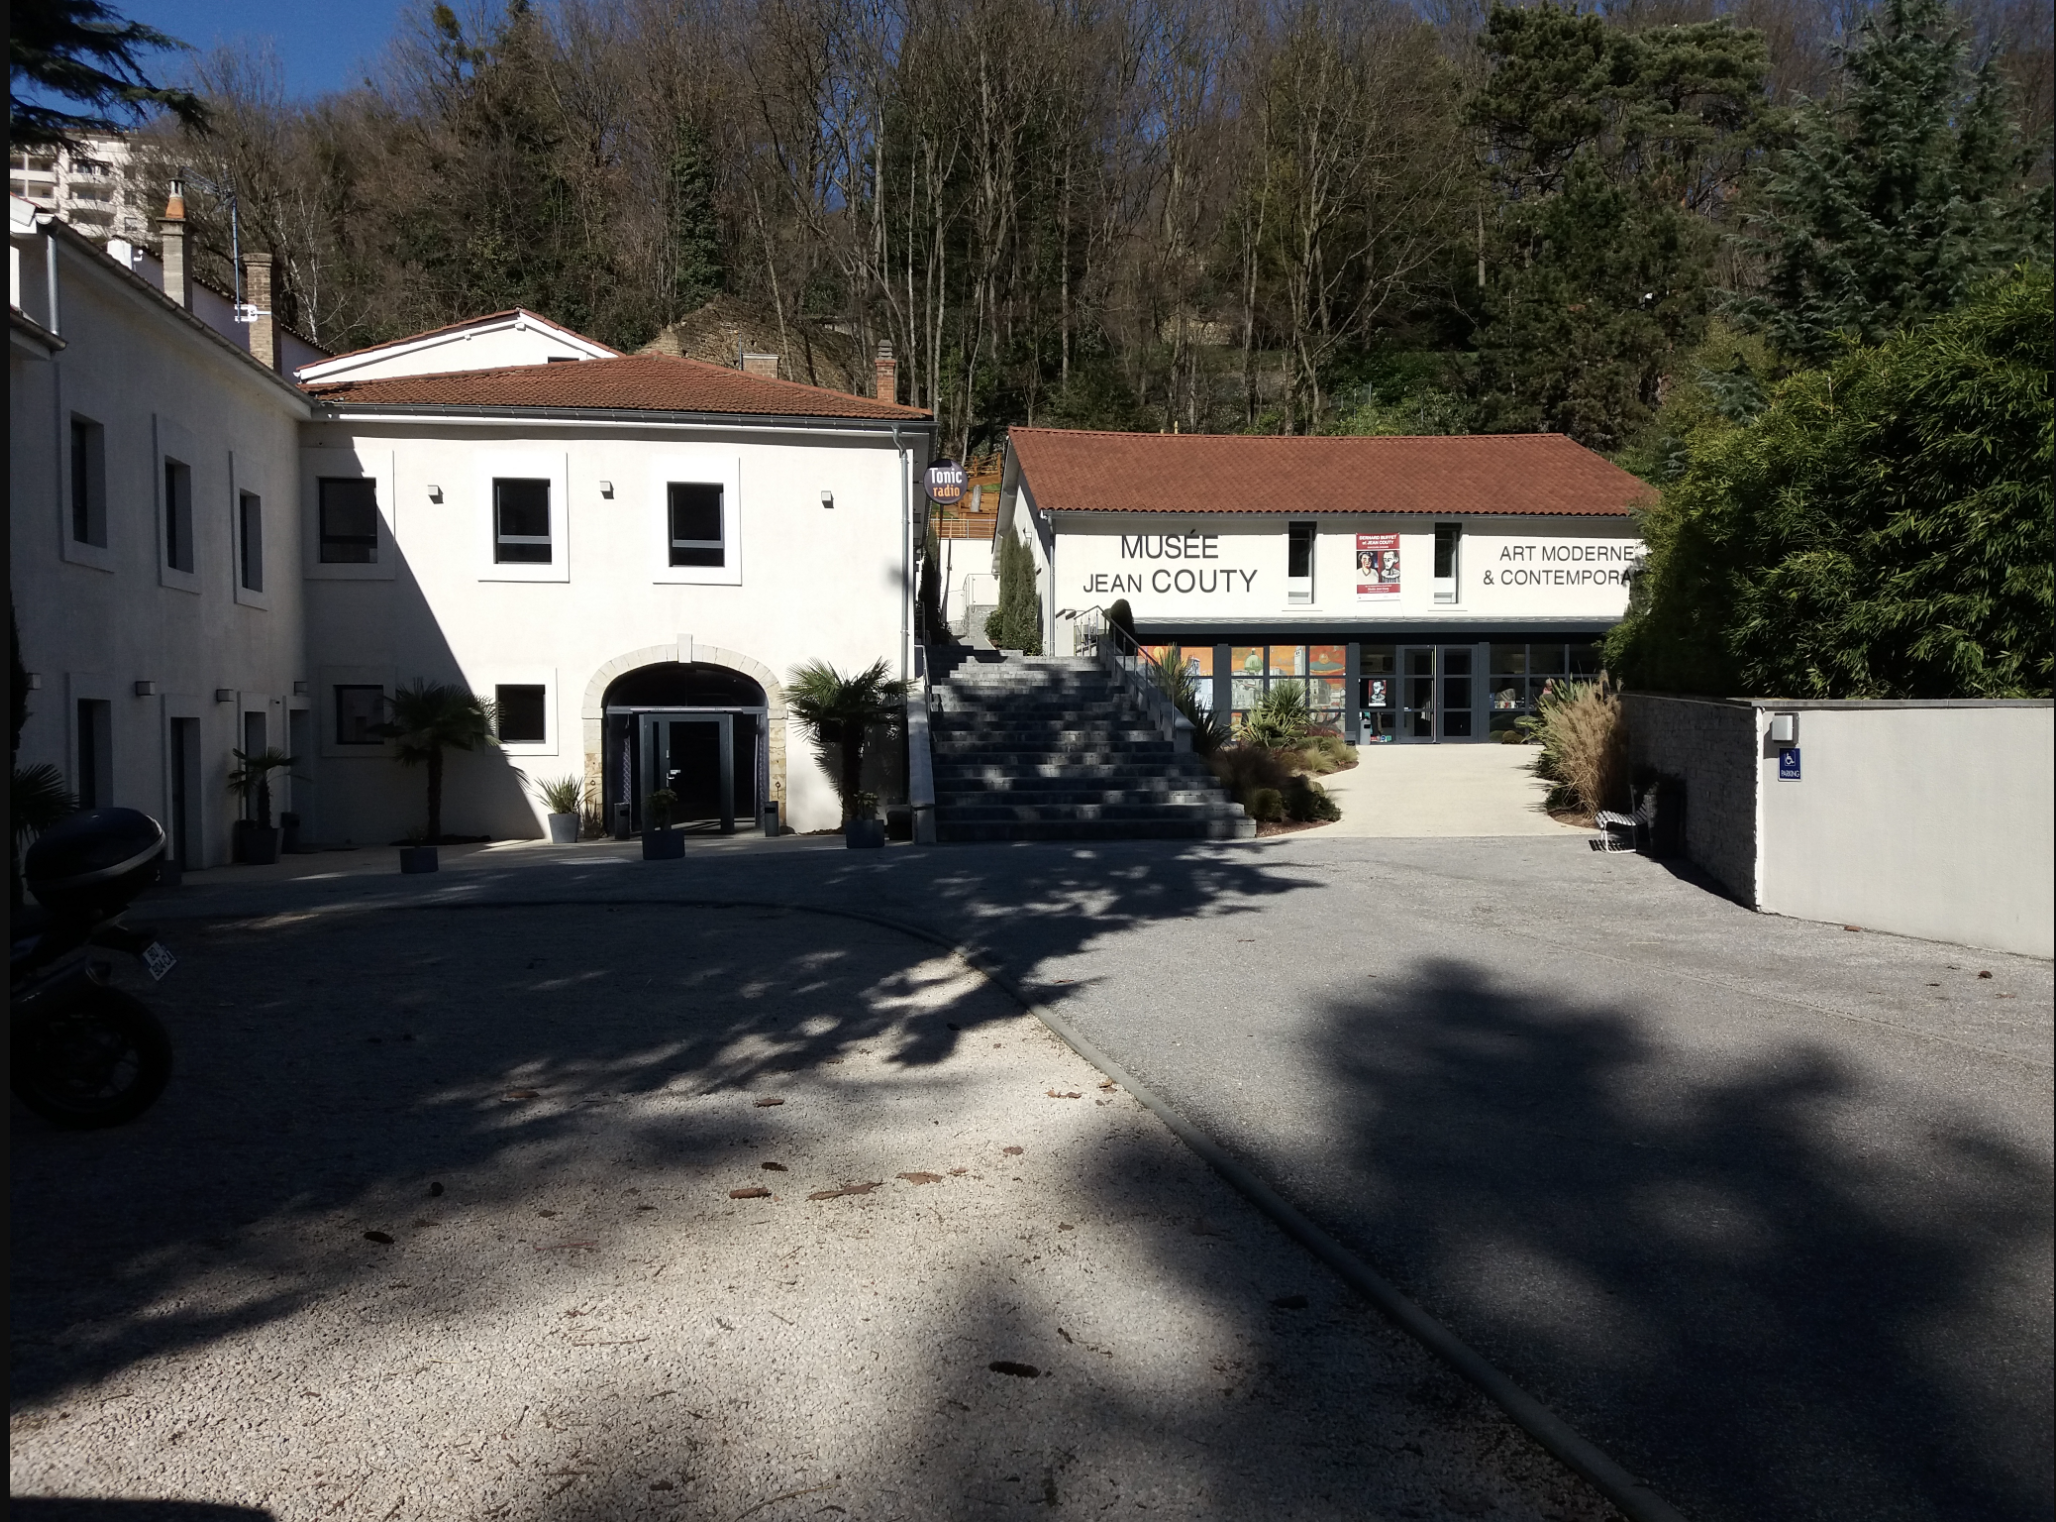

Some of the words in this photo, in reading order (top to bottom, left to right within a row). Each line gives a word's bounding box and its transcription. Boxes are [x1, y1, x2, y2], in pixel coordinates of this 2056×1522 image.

[929, 467, 963, 484] Tonic
[933, 484, 961, 497] radio
[1121, 528, 1219, 559] MUSÉE
[1499, 545, 1537, 562] ART
[1542, 545, 1635, 562] MODERNE
[1083, 573, 1142, 593] JEAN
[1152, 568, 1258, 594] COUTY
[1483, 569, 1495, 586] &
[1780, 769, 1800, 778] PARKING
